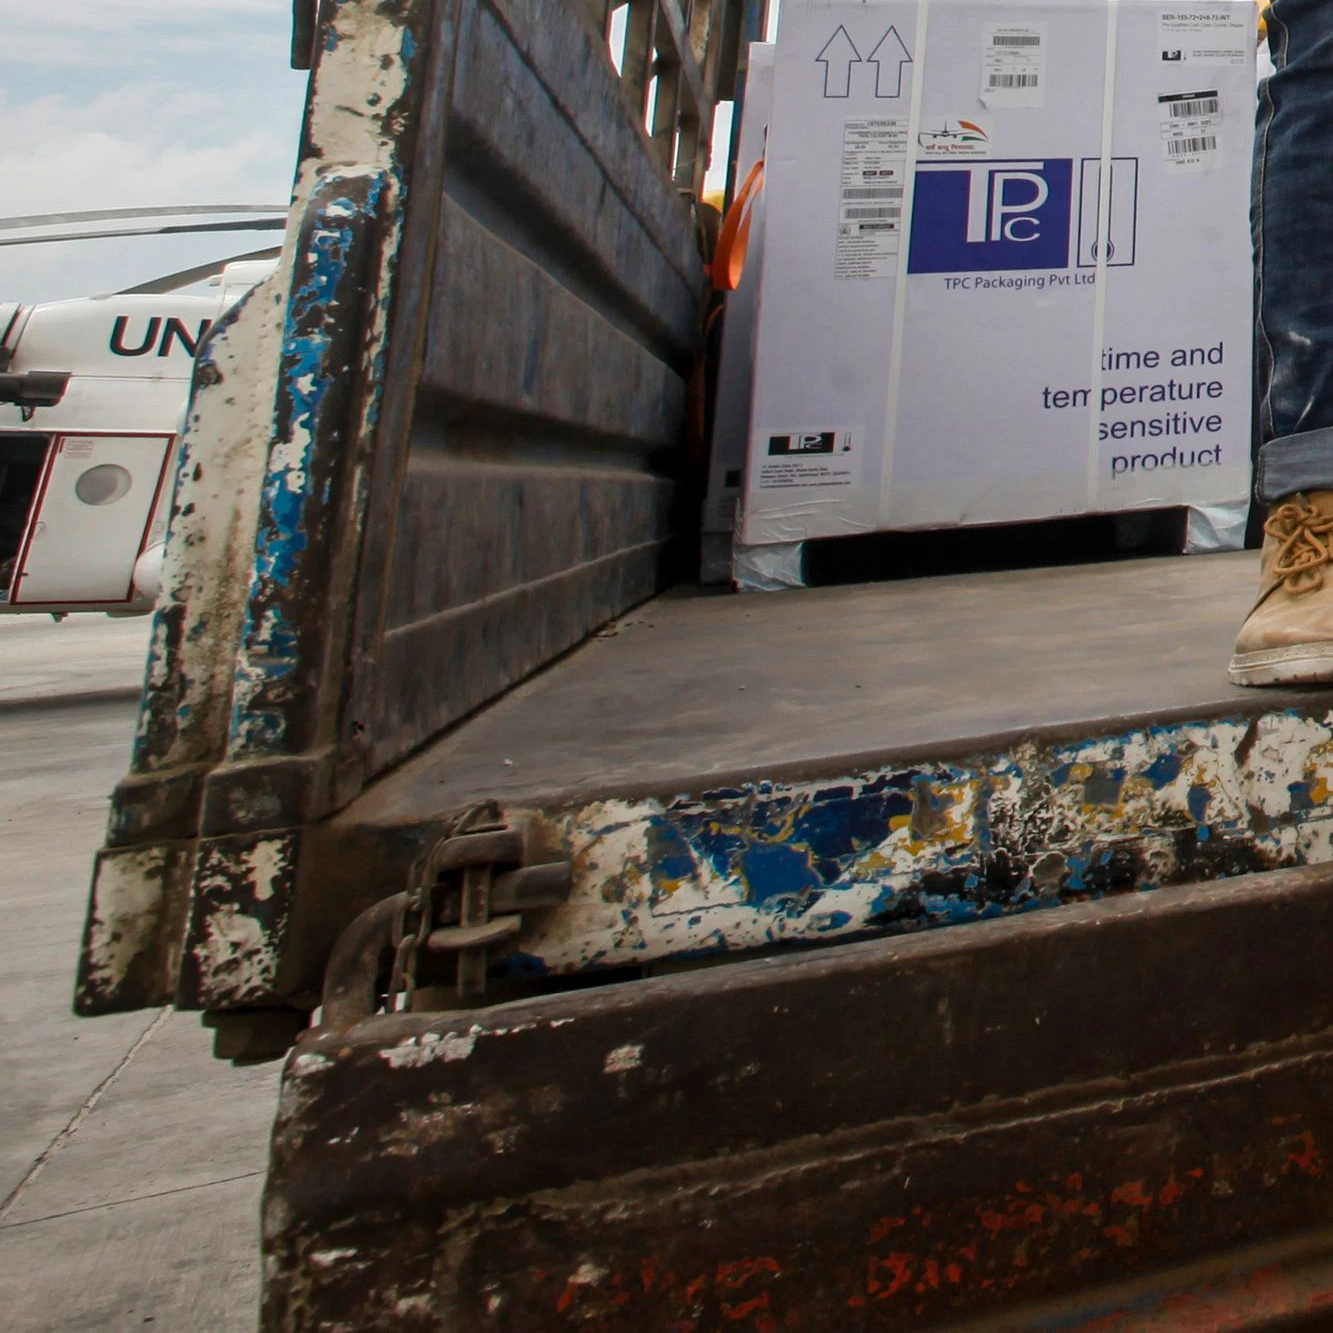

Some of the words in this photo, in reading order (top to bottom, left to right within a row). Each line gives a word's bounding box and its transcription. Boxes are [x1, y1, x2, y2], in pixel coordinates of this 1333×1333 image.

[916, 161, 1048, 243] TPC
[944, 277, 971, 290] TPC
[974, 273, 1045, 290] Packaging
[1049, 273, 1070, 287] Pvt
[1074, 271, 1096, 285] Ltd
[108, 314, 212, 358] UN
[1171, 341, 1223, 367] and
[1099, 411, 1222, 441] sensitive
[1111, 444, 1222, 480] product
